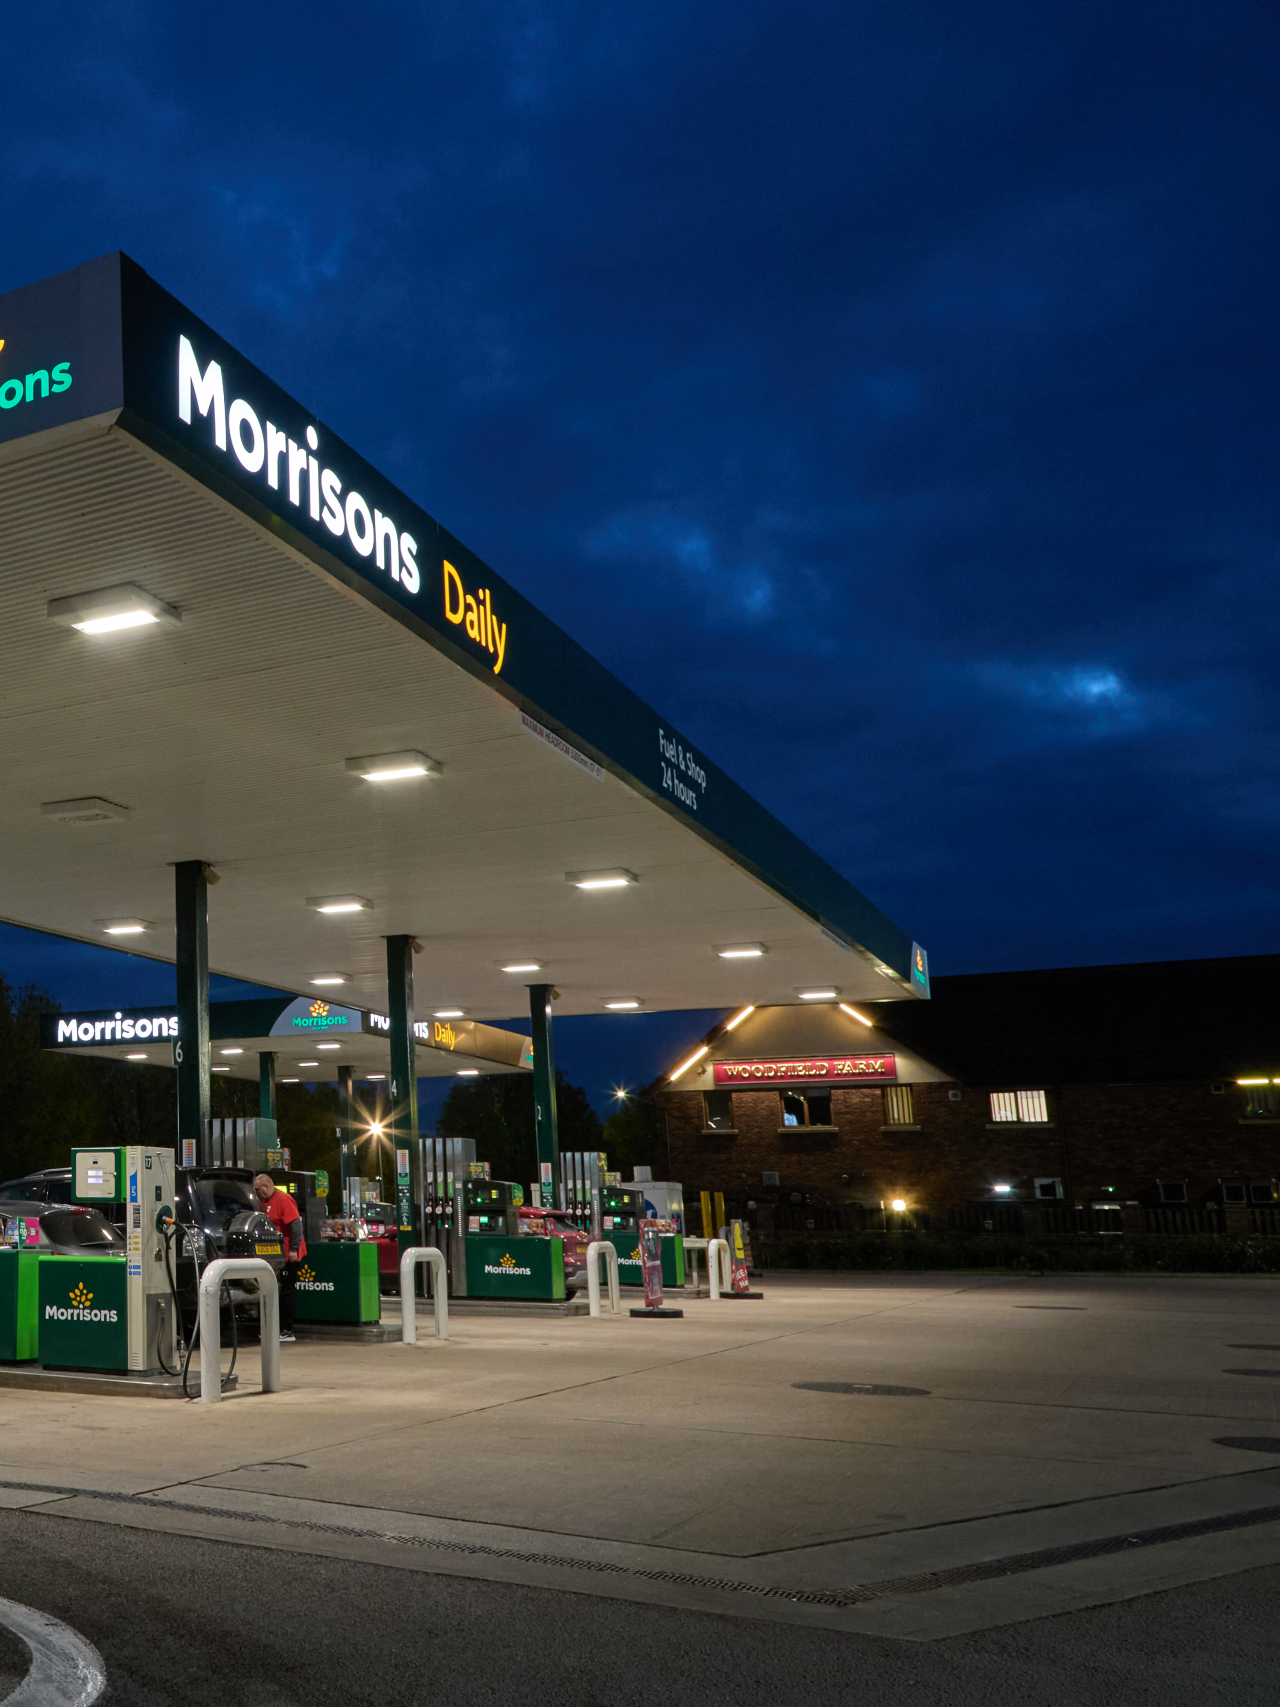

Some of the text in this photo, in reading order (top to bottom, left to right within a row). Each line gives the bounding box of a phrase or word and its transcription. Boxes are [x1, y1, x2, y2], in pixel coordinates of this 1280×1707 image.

[178, 334, 507, 675] Morrisons Daily
[658, 728, 707, 794] Fuel & Shop
[661, 761, 698, 811] 24 hours
[57, 1011, 178, 1043] Morrisons
[292, 1014, 348, 1027] Morrisons
[434, 1021, 455, 1050] Daily
[175, 1041, 183, 1063] 6
[723, 1060, 885, 1078] WOODFIELD FARM
[391, 1079, 397, 1097] 4
[276, 1138, 281, 1148] 5
[484, 1264, 531, 1275] Morrisons
[617, 1257, 642, 1266] Morris
[294, 1278, 334, 1291] rrisons
[45, 1303, 118, 1322] Morrisons
